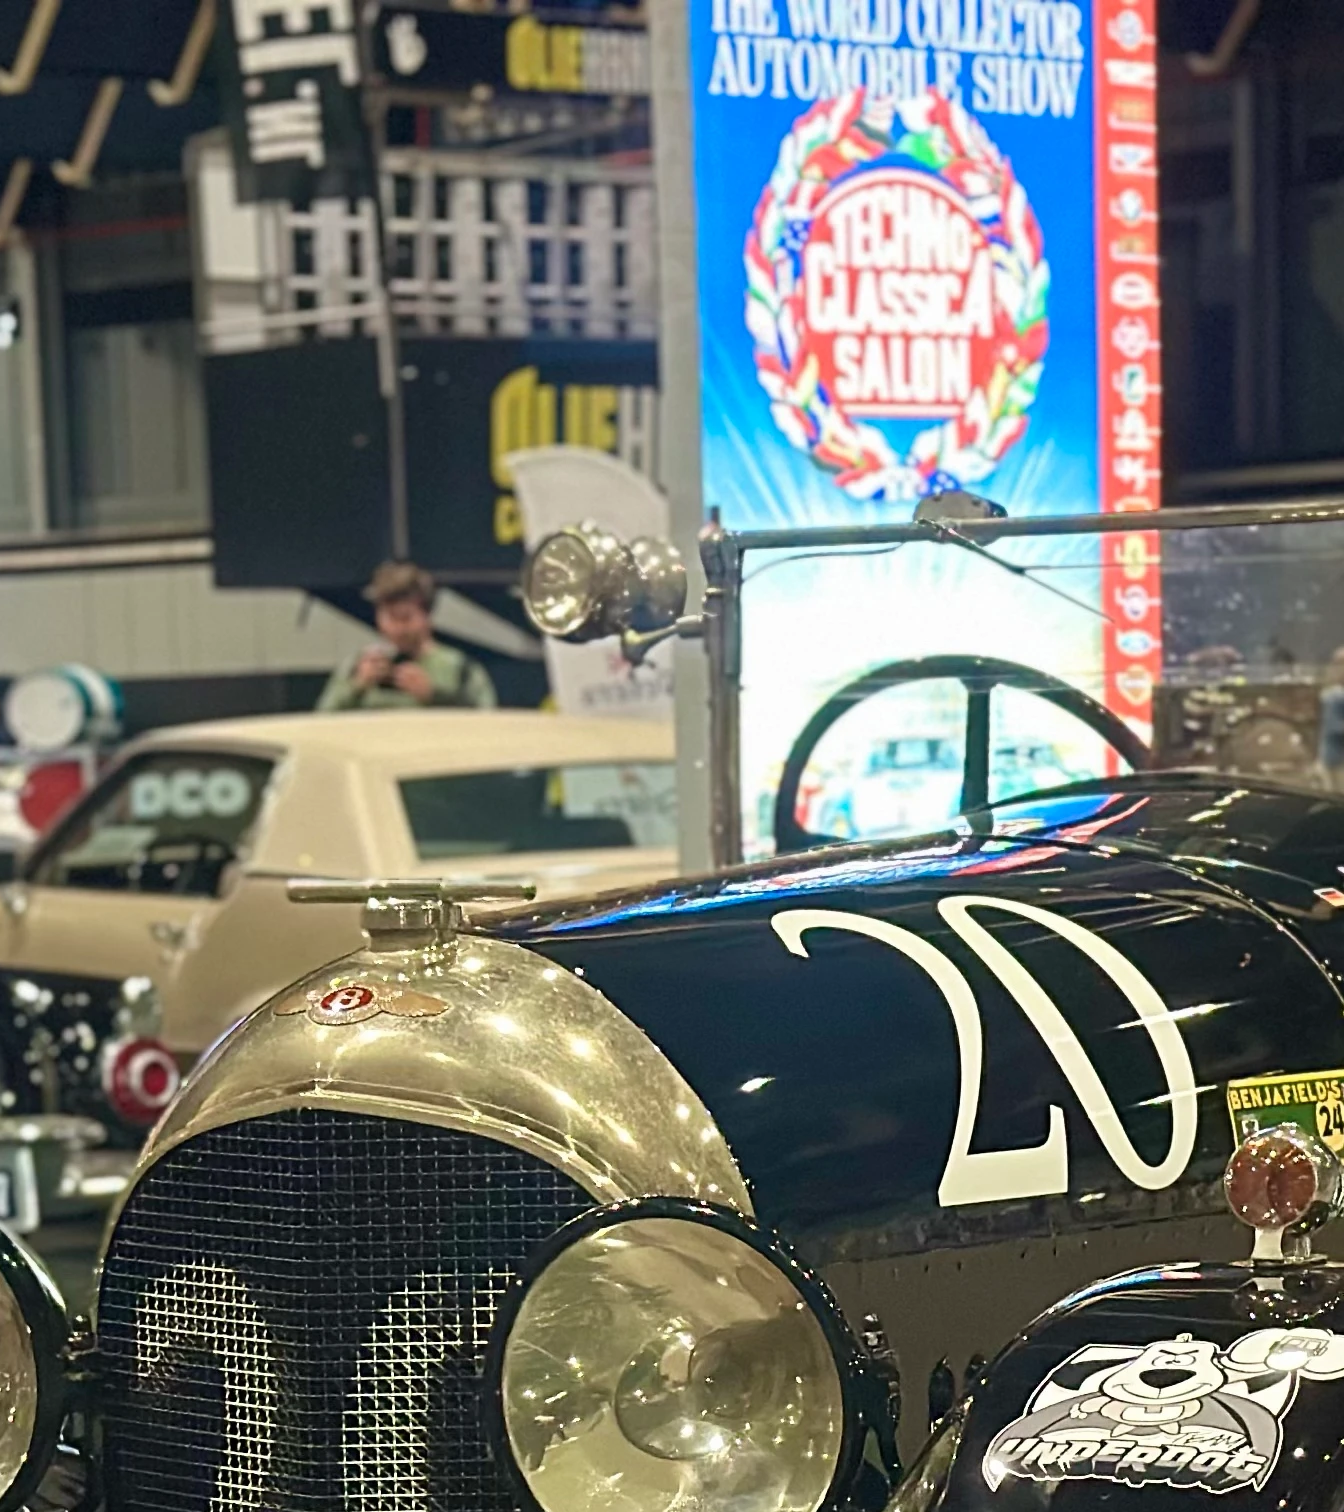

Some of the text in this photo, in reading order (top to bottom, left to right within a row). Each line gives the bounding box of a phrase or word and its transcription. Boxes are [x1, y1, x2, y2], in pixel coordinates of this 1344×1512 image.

[787, 0, 903, 45] WORLD
[905, 0, 1085, 60] COLLECTOR
[707, 35, 1084, 120] AUTOMOBILE SHOW
[827, 183, 972, 271] TECHNO
[804, 241, 995, 339] CLASSICA
[832, 335, 972, 404] SALON
[130, 769, 251, 820] DCO
[770, 895, 1199, 1209] 20
[1229, 1079, 1342, 1111] BENJAFIELD'S
[1319, 1102, 1344, 1137] 24
[999, 1436, 1269, 1484] UNDERDOG
